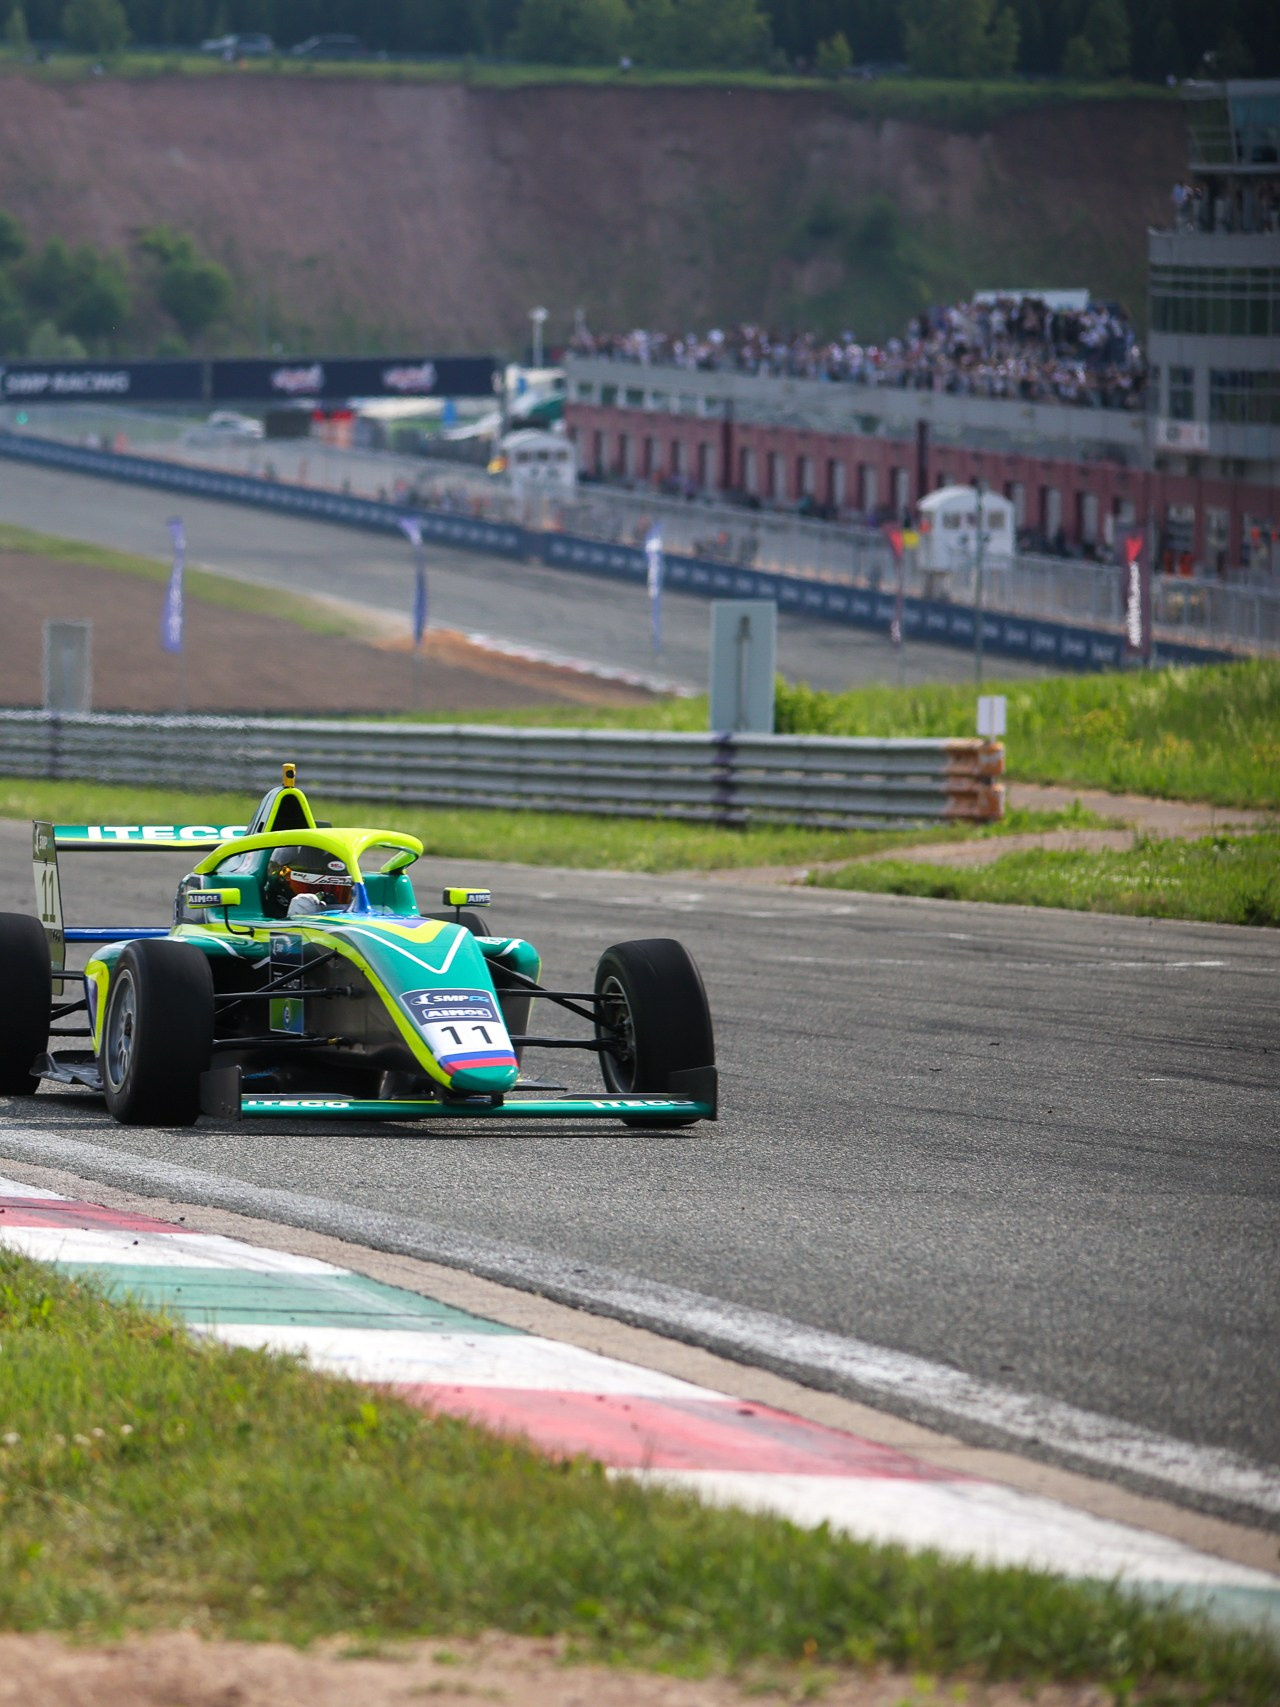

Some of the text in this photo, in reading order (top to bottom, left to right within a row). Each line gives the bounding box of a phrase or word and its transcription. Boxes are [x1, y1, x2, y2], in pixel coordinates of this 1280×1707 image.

[42, 870, 56, 923] 11
[189, 895, 219, 903] AIMOL
[433, 994, 468, 1003] SMP
[427, 1009, 488, 1018] AIMOL
[441, 1025, 493, 1045] 11
[248, 1100, 350, 1109] ITECO
